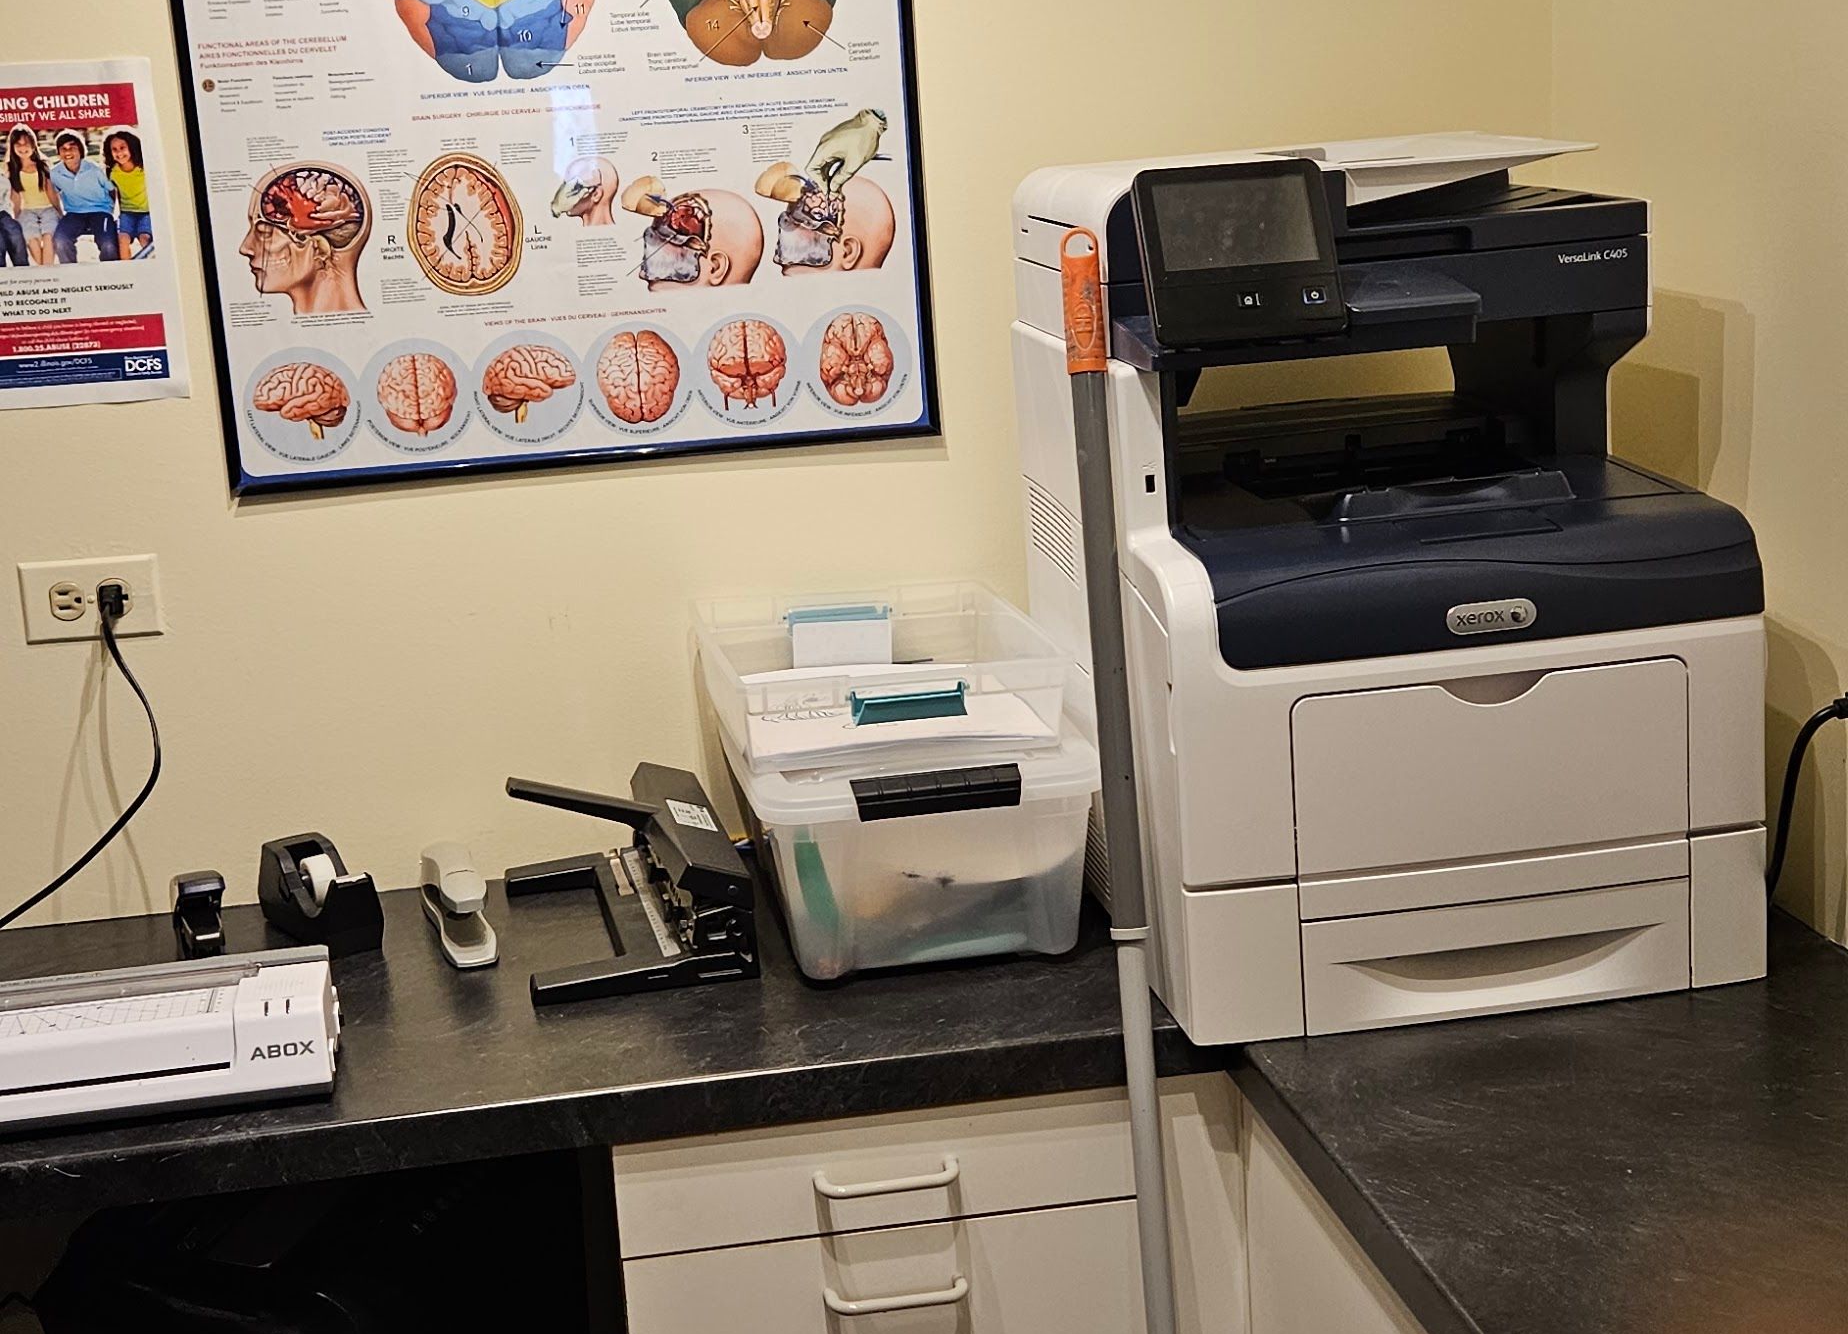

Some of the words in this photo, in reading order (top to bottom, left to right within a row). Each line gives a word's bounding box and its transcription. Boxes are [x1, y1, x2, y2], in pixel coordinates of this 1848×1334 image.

[462, 6, 470, 16] 9
[575, 4, 585, 14] 11
[706, 20, 720, 30] 14
[299, 35, 347, 44] CEREBELLUM
[518, 30, 532, 42] 10
[466, 64, 472, 75] 1
[33, 93, 109, 109] CHILDREN
[39, 111, 56, 121] WE
[59, 110, 76, 120] ALL
[79, 109, 111, 119] SHARE
[743, 125, 749, 135] 3
[570, 137, 574, 147] 1
[652, 152, 658, 162] 2
[534, 225, 542, 235] L
[388, 235, 396, 244] R
[525, 235, 552, 243] GAUCHE
[381, 245, 405, 254] DROITE
[1558, 251, 1601, 264] VersaLink
[1604, 248, 1628, 260] C405
[16, 288, 39, 296] ABUSE
[16, 298, 58, 306] RECOGNIZE
[125, 358, 162, 373] DCFS
[1457, 610, 1505, 627] xerox
[250, 1040, 316, 1061] ABOX
